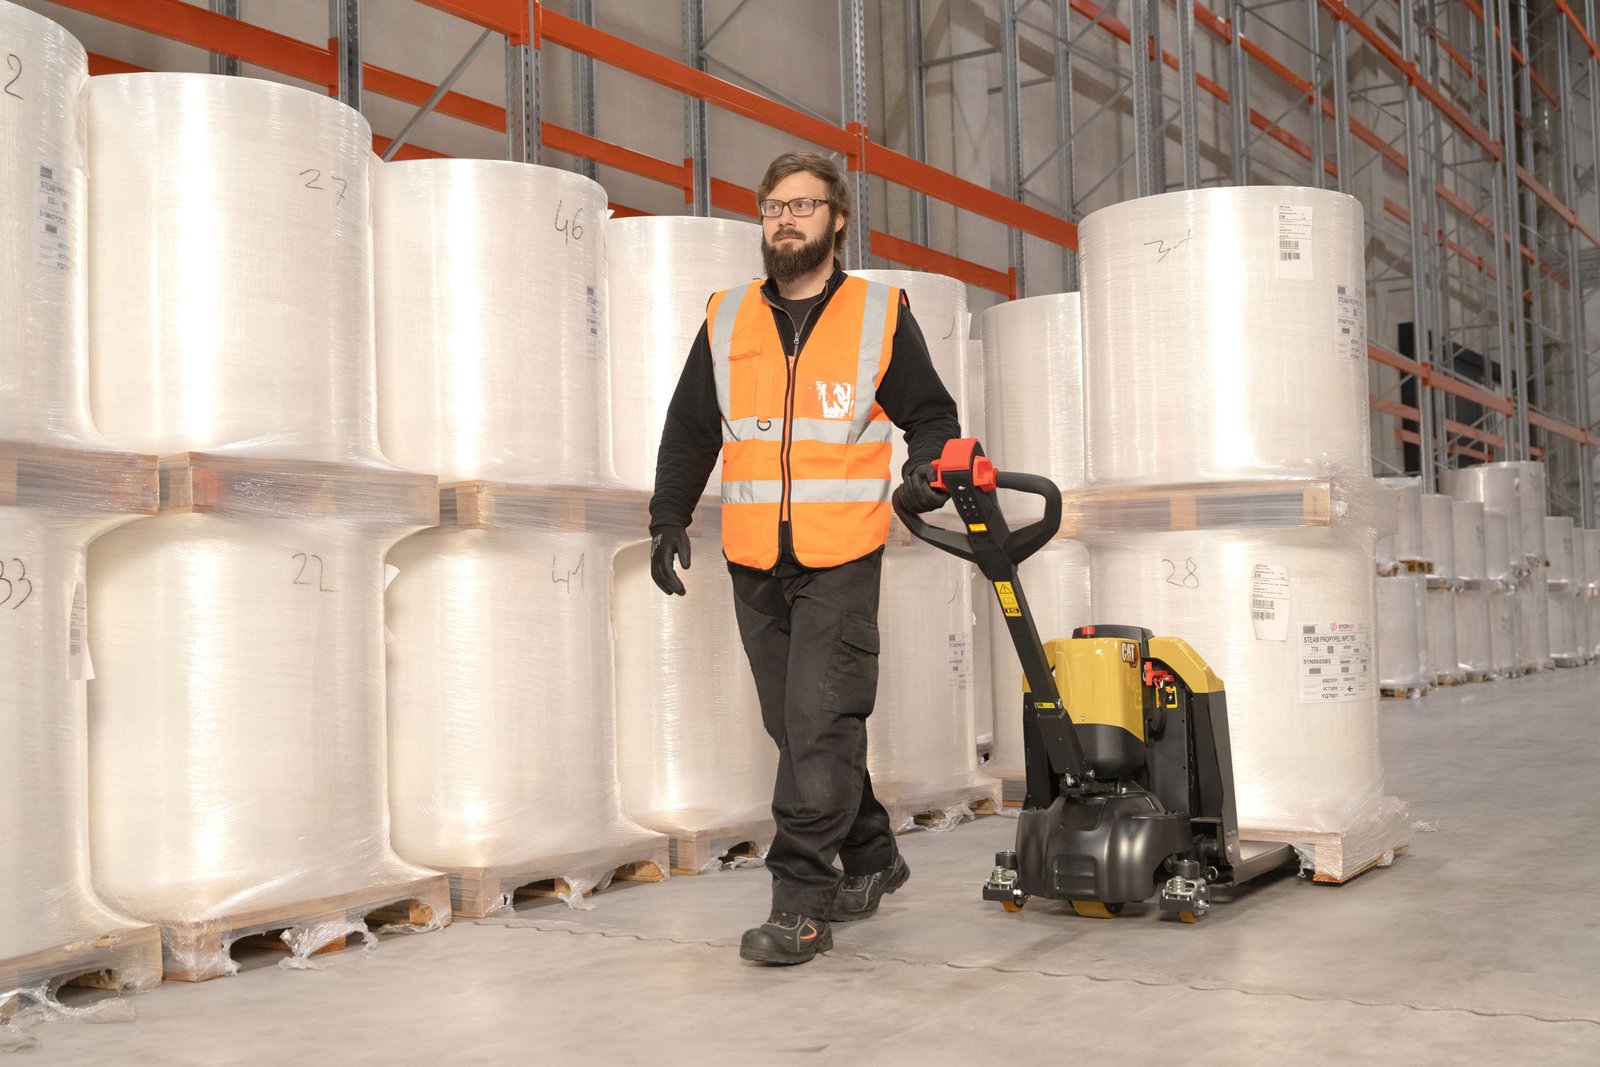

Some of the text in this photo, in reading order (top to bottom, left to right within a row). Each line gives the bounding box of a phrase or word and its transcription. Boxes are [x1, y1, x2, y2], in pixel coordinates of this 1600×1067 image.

[299, 168, 348, 207] 27
[554, 199, 584, 246] 46
[291, 551, 336, 593] 22
[551, 552, 585, 594] 41
[1161, 556, 1200, 590] 28
[1121, 642, 1135, 664] CAT
[1303, 636, 1320, 644] STEAM
